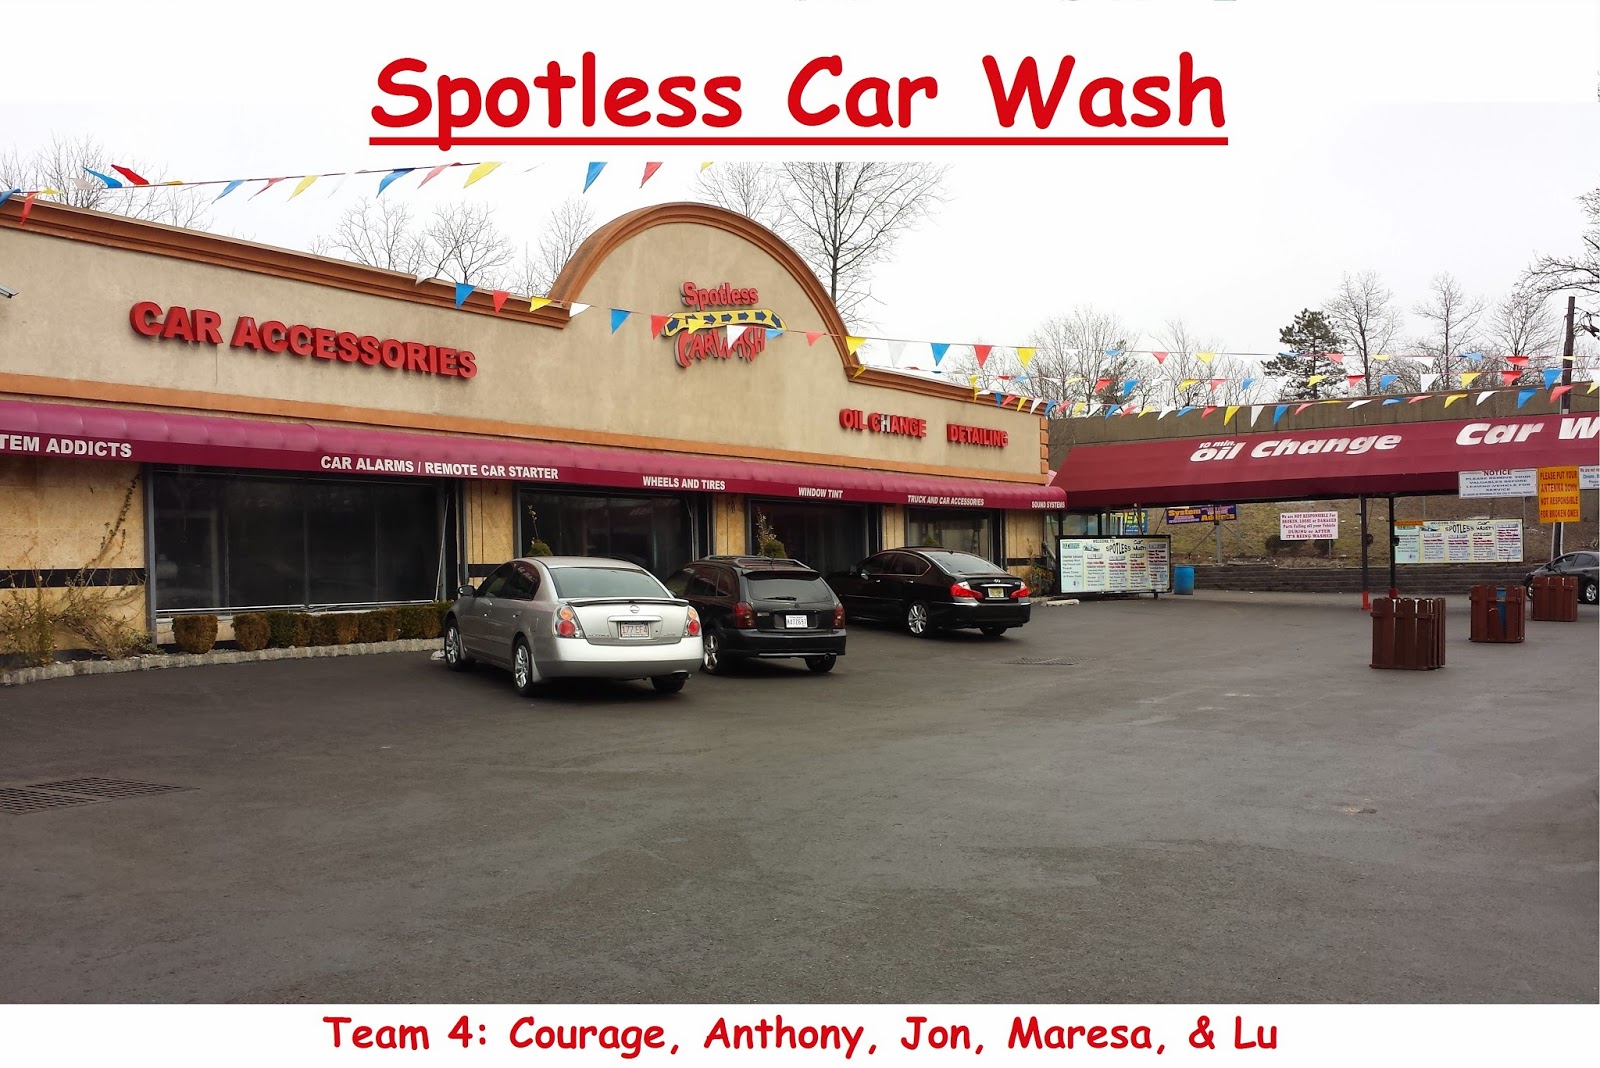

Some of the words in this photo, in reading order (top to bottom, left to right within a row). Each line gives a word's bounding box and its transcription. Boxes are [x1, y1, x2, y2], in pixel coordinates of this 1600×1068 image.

[680, 281, 759, 311] Spotless
[130, 301, 222, 344] CAR
[231, 316, 477, 379] ACCESSORIES
[839, 408, 867, 430] OIL
[868, 412, 927, 438] CHANGE
[947, 423, 1008, 448] DETAILING
[1456, 422, 1544, 446] Car
[46, 438, 132, 458] ADDICTS
[1250, 434, 1403, 458] Change
[321, 456, 352, 470] CAR
[356, 458, 414, 473] ALARMS
[424, 462, 478, 476] REMOTE
[481, 465, 505, 477] CAR
[508, 466, 558, 480] STARTER
[1540, 472, 1556, 480] PLEASE
[1566, 471, 1577, 479] YOUR
[642, 476, 680, 488] WHEELS
[682, 478, 699, 489] AND
[701, 478, 725, 490] TIRES
[1541, 483, 1564, 493] ANTENNA
[1565, 483, 1577, 492] DOWN
[798, 486, 826, 498] WINDOW
[828, 488, 843, 498] TINT
[907, 494, 926, 504] TRUCK
[927, 495, 938, 504] AND
[939, 496, 951, 505] CAR
[952, 496, 984, 506] ACCESSORIES
[1541, 497, 1549, 505] NOT
[1550, 496, 1578, 505] RESPONSIBLE
[1549, 509, 1566, 518] BROKEN
[1568, 509, 1579, 517] ONES
[1445, 524, 1474, 533] SPOTLESS
[1106, 543, 1131, 554] SPOTLESS
